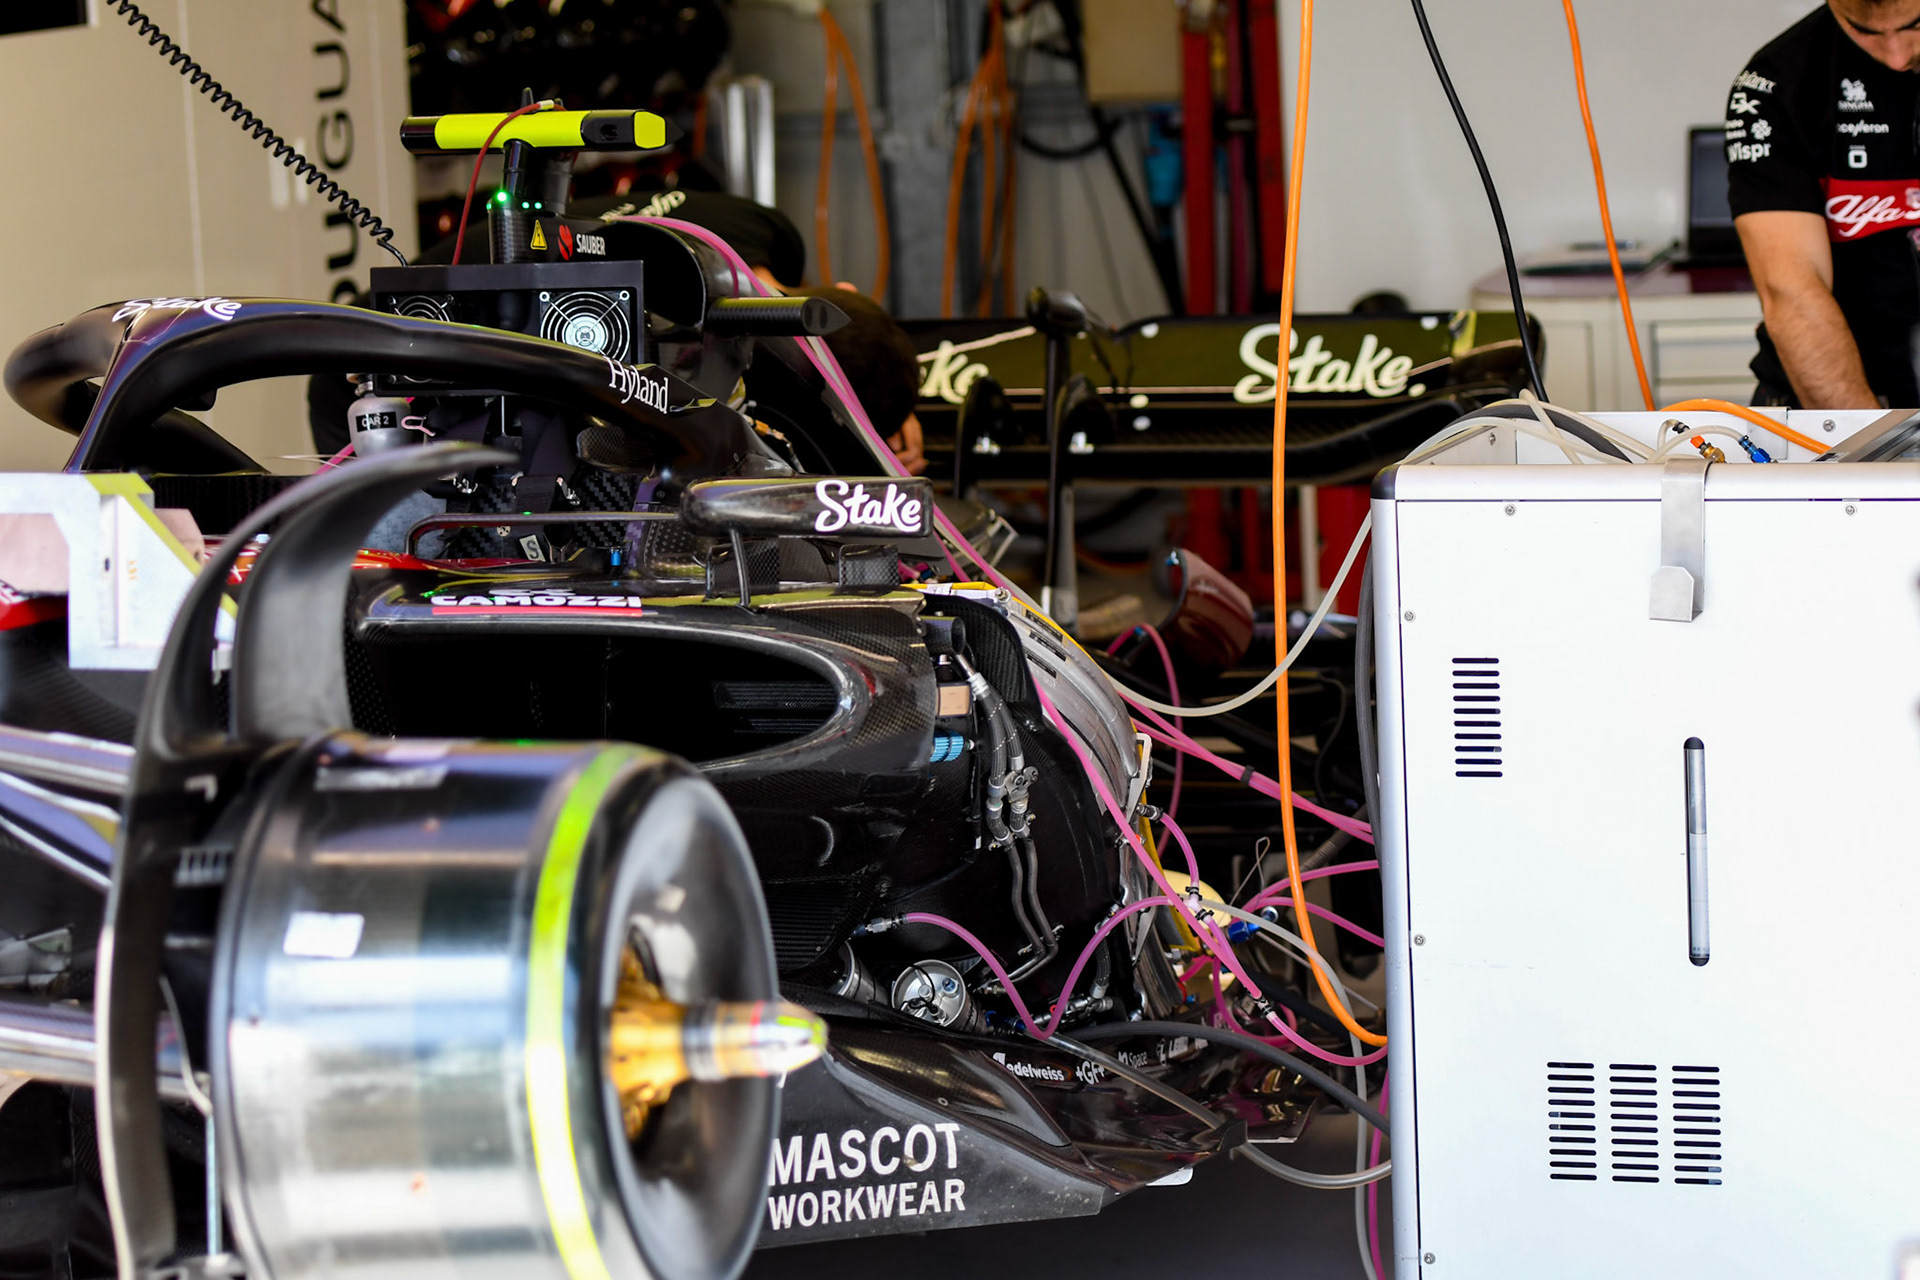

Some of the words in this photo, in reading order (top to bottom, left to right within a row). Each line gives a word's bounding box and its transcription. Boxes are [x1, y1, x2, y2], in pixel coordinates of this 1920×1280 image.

[576, 233, 606, 256] SAUBER
[111, 297, 243, 322] Stake
[602, 355, 669, 414] Hyland
[1233, 323, 1414, 404] Stake
[361, 415, 381, 428] CAR
[382, 415, 390, 425] 2
[815, 479, 922, 532] Stake
[431, 595, 642, 608] CAMOZZI
[767, 1122, 960, 1187] MASCOT
[768, 1178, 966, 1231] WORKWEAR
